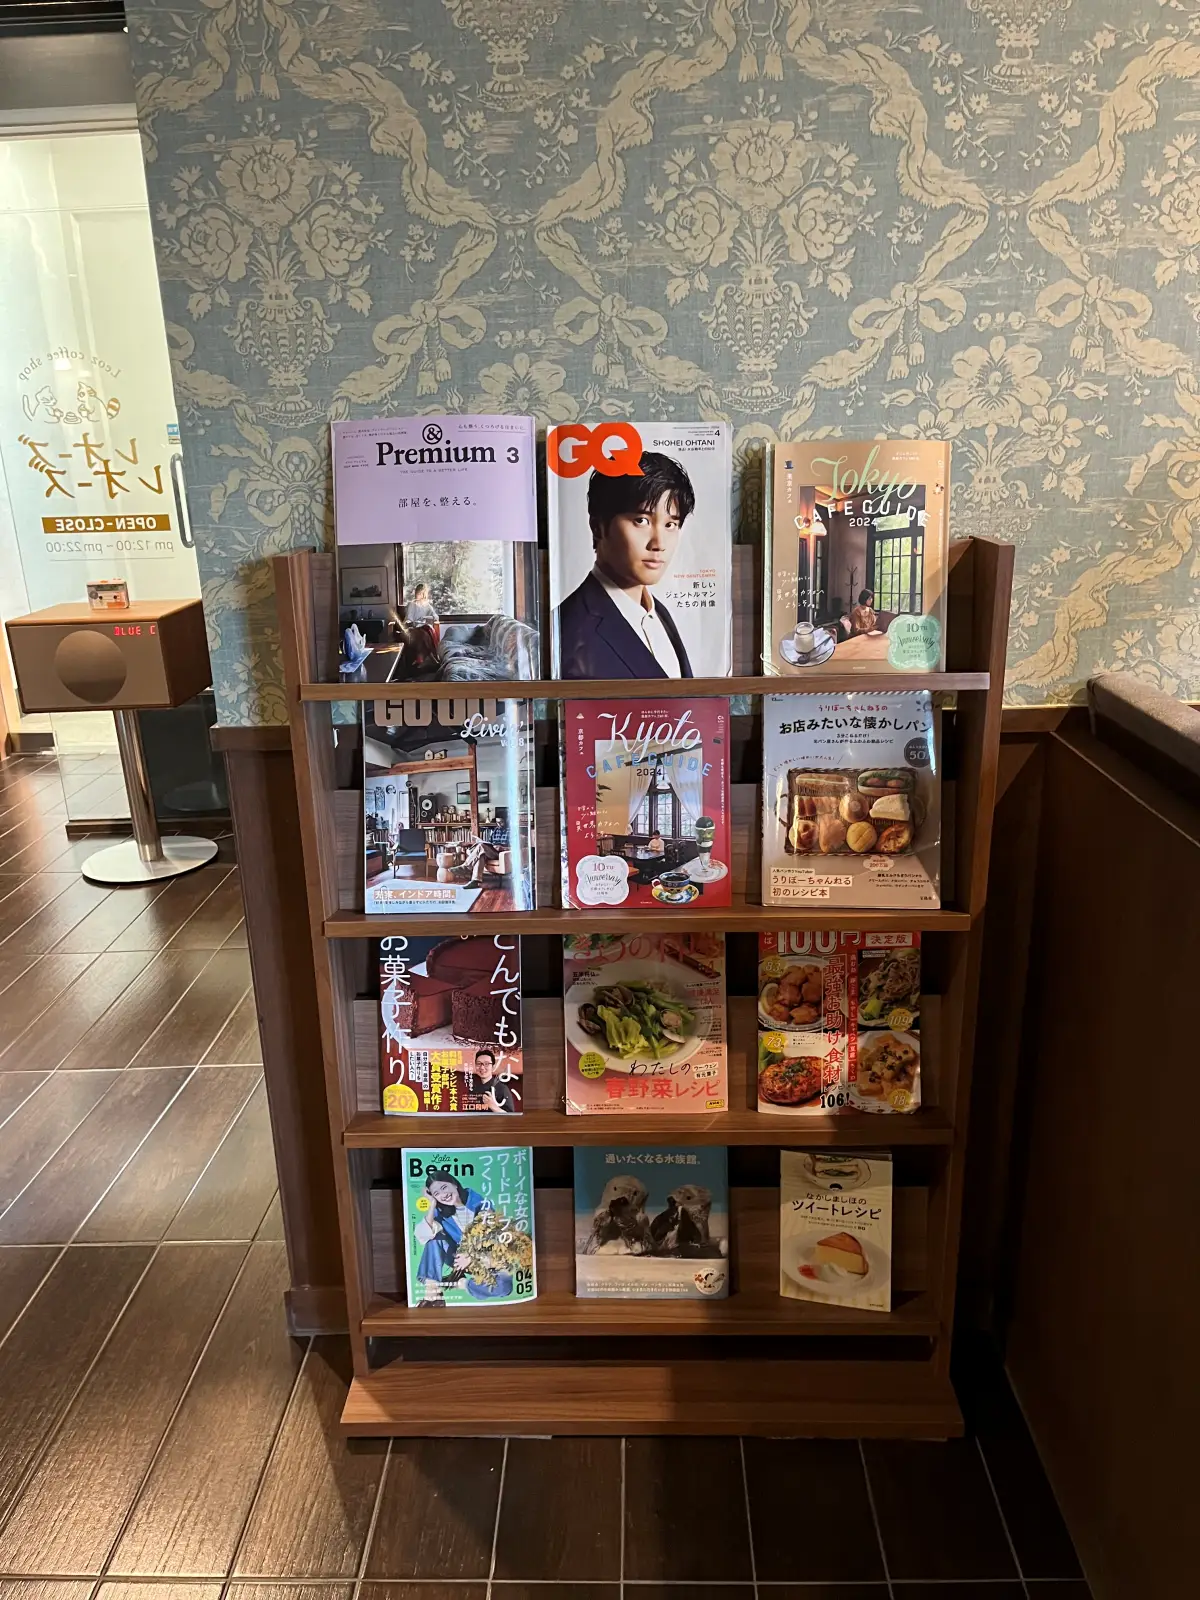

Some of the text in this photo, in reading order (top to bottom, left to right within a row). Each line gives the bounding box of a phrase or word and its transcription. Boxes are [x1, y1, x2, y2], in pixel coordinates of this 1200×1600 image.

[376, 440, 496, 467] Premium
[506, 447, 520, 463] 3
[547, 422, 646, 478] GQ
[811, 445, 917, 515] Tokyo
[398, 496, 478, 508] 部屋を、整える。
[794, 500, 931, 529] CAFE GUIDE
[849, 518, 877, 527] 2024
[779, 716, 932, 734] お店みたいな懐かしパン
[597, 710, 702, 762] Kyoto
[586, 752, 713, 778] CAFE GUIDE
[636, 768, 662, 776] 2024
[772, 876, 851, 885] うりぼーちゃんねる
[772, 888, 828, 897] 初のレシピ本
[870, 934, 908, 944] 決定版
[824, 957, 845, 1083] 最強お助け食材
[629, 1060, 691, 1076] わたしの
[605, 1077, 720, 1099] 春野菜レシピ
[409, 1158, 474, 1177] Begin
[605, 1154, 701, 1165] 通いたくなる水族館。
[479, 1155, 496, 1225] つくりかた
[497, 1153, 513, 1244] ワードローブの
[513, 1149, 529, 1232] ボーイな女の
[806, 1193, 867, 1205] なかしましほの
[792, 1200, 882, 1220] ツイートレシピ
[516, 1269, 532, 1282] 04
[516, 1281, 532, 1294] 05
